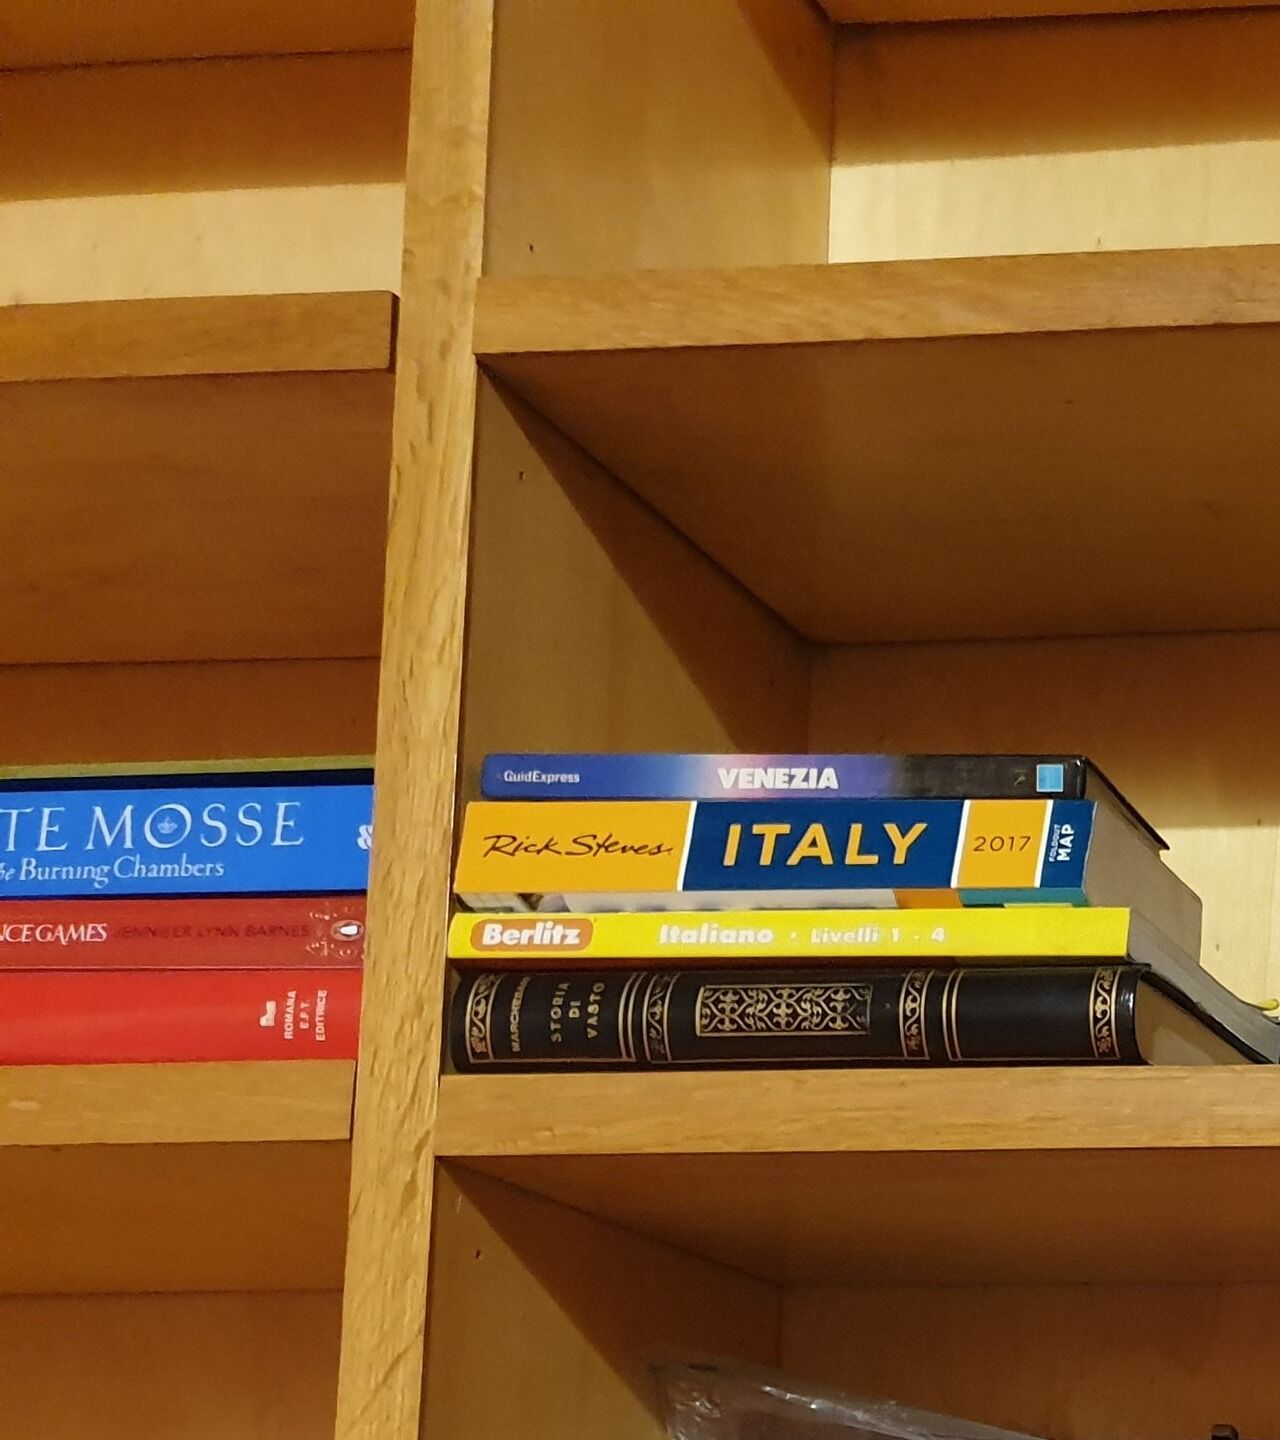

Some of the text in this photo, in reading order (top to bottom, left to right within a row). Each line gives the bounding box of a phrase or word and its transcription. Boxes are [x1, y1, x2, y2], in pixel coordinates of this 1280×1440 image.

[503, 770, 580, 785] GuidExpress
[718, 767, 839, 790] VENEZIA
[86, 801, 305, 851] MOSSE
[483, 834, 563, 858] Rick
[722, 822, 928, 867] ITALY
[972, 835, 1033, 852] 2017
[1049, 823, 1061, 862] FOLDOUT
[1056, 823, 1075, 861] MAP
[19, 857, 110, 889] Burning
[113, 853, 225, 879] Chambers
[36, 922, 108, 943] GAMES
[114, 922, 311, 939] JENNIFER LYNN BARNES
[482, 921, 582, 947] Berlitz
[659, 924, 776, 946] Italiano
[810, 927, 880, 945] Livelli
[931, 927, 946, 944] 4
[283, 990, 298, 1040] ROMANA
[315, 990, 328, 1041] EDITRICE
[550, 981, 570, 1043] STORIA
[568, 1000, 581, 1019] DI
[586, 982, 605, 1040] VASTO
